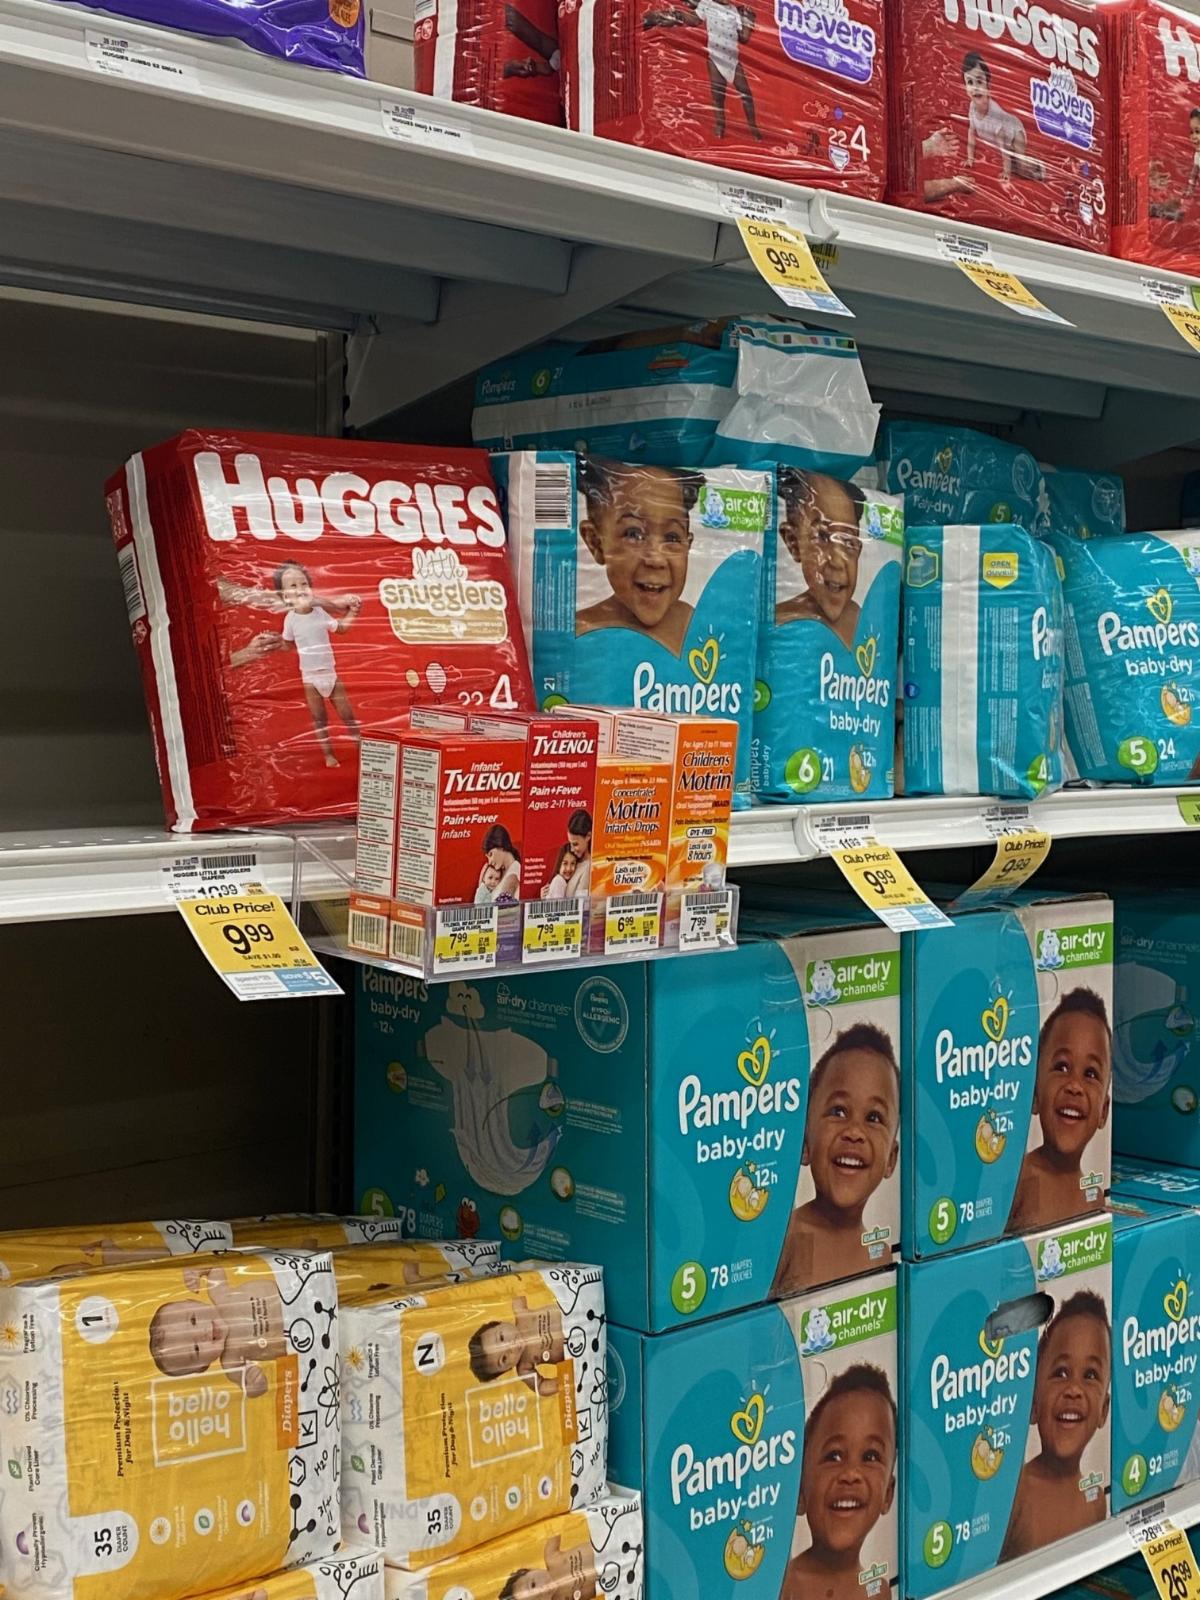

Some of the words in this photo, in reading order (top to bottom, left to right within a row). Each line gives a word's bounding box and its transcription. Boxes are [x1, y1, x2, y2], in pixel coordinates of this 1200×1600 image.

[778, 2, 873, 52] movers
[1032, 81, 1092, 122] movers
[828, 127, 848, 149] 22
[851, 124, 871, 161] 4
[748, 226, 770, 239] Club
[536, 369, 546, 388] 6
[194, 451, 506, 548] HUGGIES
[995, 505, 1006, 522] 5
[416, 552, 465, 579] little
[383, 579, 503, 612] snugglers
[1097, 612, 1199, 655] Pampers
[1125, 656, 1193, 675] baby-dry
[633, 662, 741, 715] Pampers
[820, 652, 889, 711] Pampers
[552, 730, 586, 740] Children's
[830, 710, 881, 737] baby-dry
[533, 736, 595, 756] TYLENOL
[1130, 740, 1147, 766] 5
[1158, 738, 1176, 760] 24
[471, 762, 504, 773] Infants'
[683, 752, 730, 768] Children's
[799, 754, 814, 783] 6
[822, 757, 834, 781] 21
[444, 769, 522, 796] TYLENOL
[678, 770, 732, 792] Motrin
[528, 800, 549, 811] Ages
[566, 800, 587, 808] Years
[606, 800, 660, 820] Motrin
[635, 822, 660, 834] Drops
[694, 850, 712, 860] hours
[843, 854, 863, 864] Club
[864, 852, 891, 862] Price!
[1004, 840, 1022, 852] Club
[1024, 838, 1046, 850] Price!
[622, 874, 643, 884] hours
[195, 903, 230, 916] Club
[234, 901, 276, 914] Price!
[1061, 929, 1105, 951] air-dry
[1066, 949, 1100, 962] channels
[837, 958, 891, 986] air-dry
[496, 994, 526, 1010] air-dry
[843, 981, 885, 997] channels
[371, 998, 420, 1023] baby-dry
[583, 1012, 620, 1024] ALLERGENIC
[935, 1029, 1032, 1083] Pampers
[678, 1074, 801, 1136] Pampers
[950, 1079, 1020, 1110] baby-dry
[994, 1117, 1013, 1133] 12h
[697, 1127, 786, 1163] baby-dry
[755, 1168, 778, 1187] 12h
[937, 1203, 948, 1230] 5
[960, 1201, 974, 1224] 78
[1063, 1229, 1107, 1258] air-dry
[1067, 1251, 1102, 1270] channels
[681, 1266, 696, 1299] 5
[710, 1264, 729, 1290] 78
[81, 1315, 103, 1328] 1
[832, 1297, 887, 1328] air-dry
[838, 1319, 882, 1341] channels
[418, 1342, 434, 1367] N
[931, 1347, 1030, 1409] Pampers
[1135, 1354, 1197, 1388] baby-dry
[121, 1392, 132, 1419] Night
[168, 1387, 230, 1418] bello
[282, 1370, 294, 1433] Diapers
[480, 1393, 527, 1422] bello
[564, 1374, 573, 1430] Diapers
[945, 1393, 1018, 1434] baby-dry
[122, 1427, 132, 1448] Day
[168, 1413, 231, 1447] hello
[482, 1417, 529, 1447] hello
[992, 1431, 1011, 1449] 12h
[114, 1432, 124, 1478] Premium
[122, 1448, 134, 1464] for
[443, 1437, 451, 1478] Premium
[670, 1430, 796, 1505] Pampers
[1128, 1458, 1140, 1483] 4
[1150, 1455, 1163, 1476] 92
[690, 1482, 781, 1531] baby-dry
[30, 1512, 38, 1538] Proven
[427, 1509, 442, 1535] 35
[94, 1528, 112, 1558] 35
[931, 1523, 944, 1554] 5
[955, 1521, 970, 1545] 78
[1148, 1542, 1164, 1556] Club
[1165, 1534, 1182, 1549] Price!
